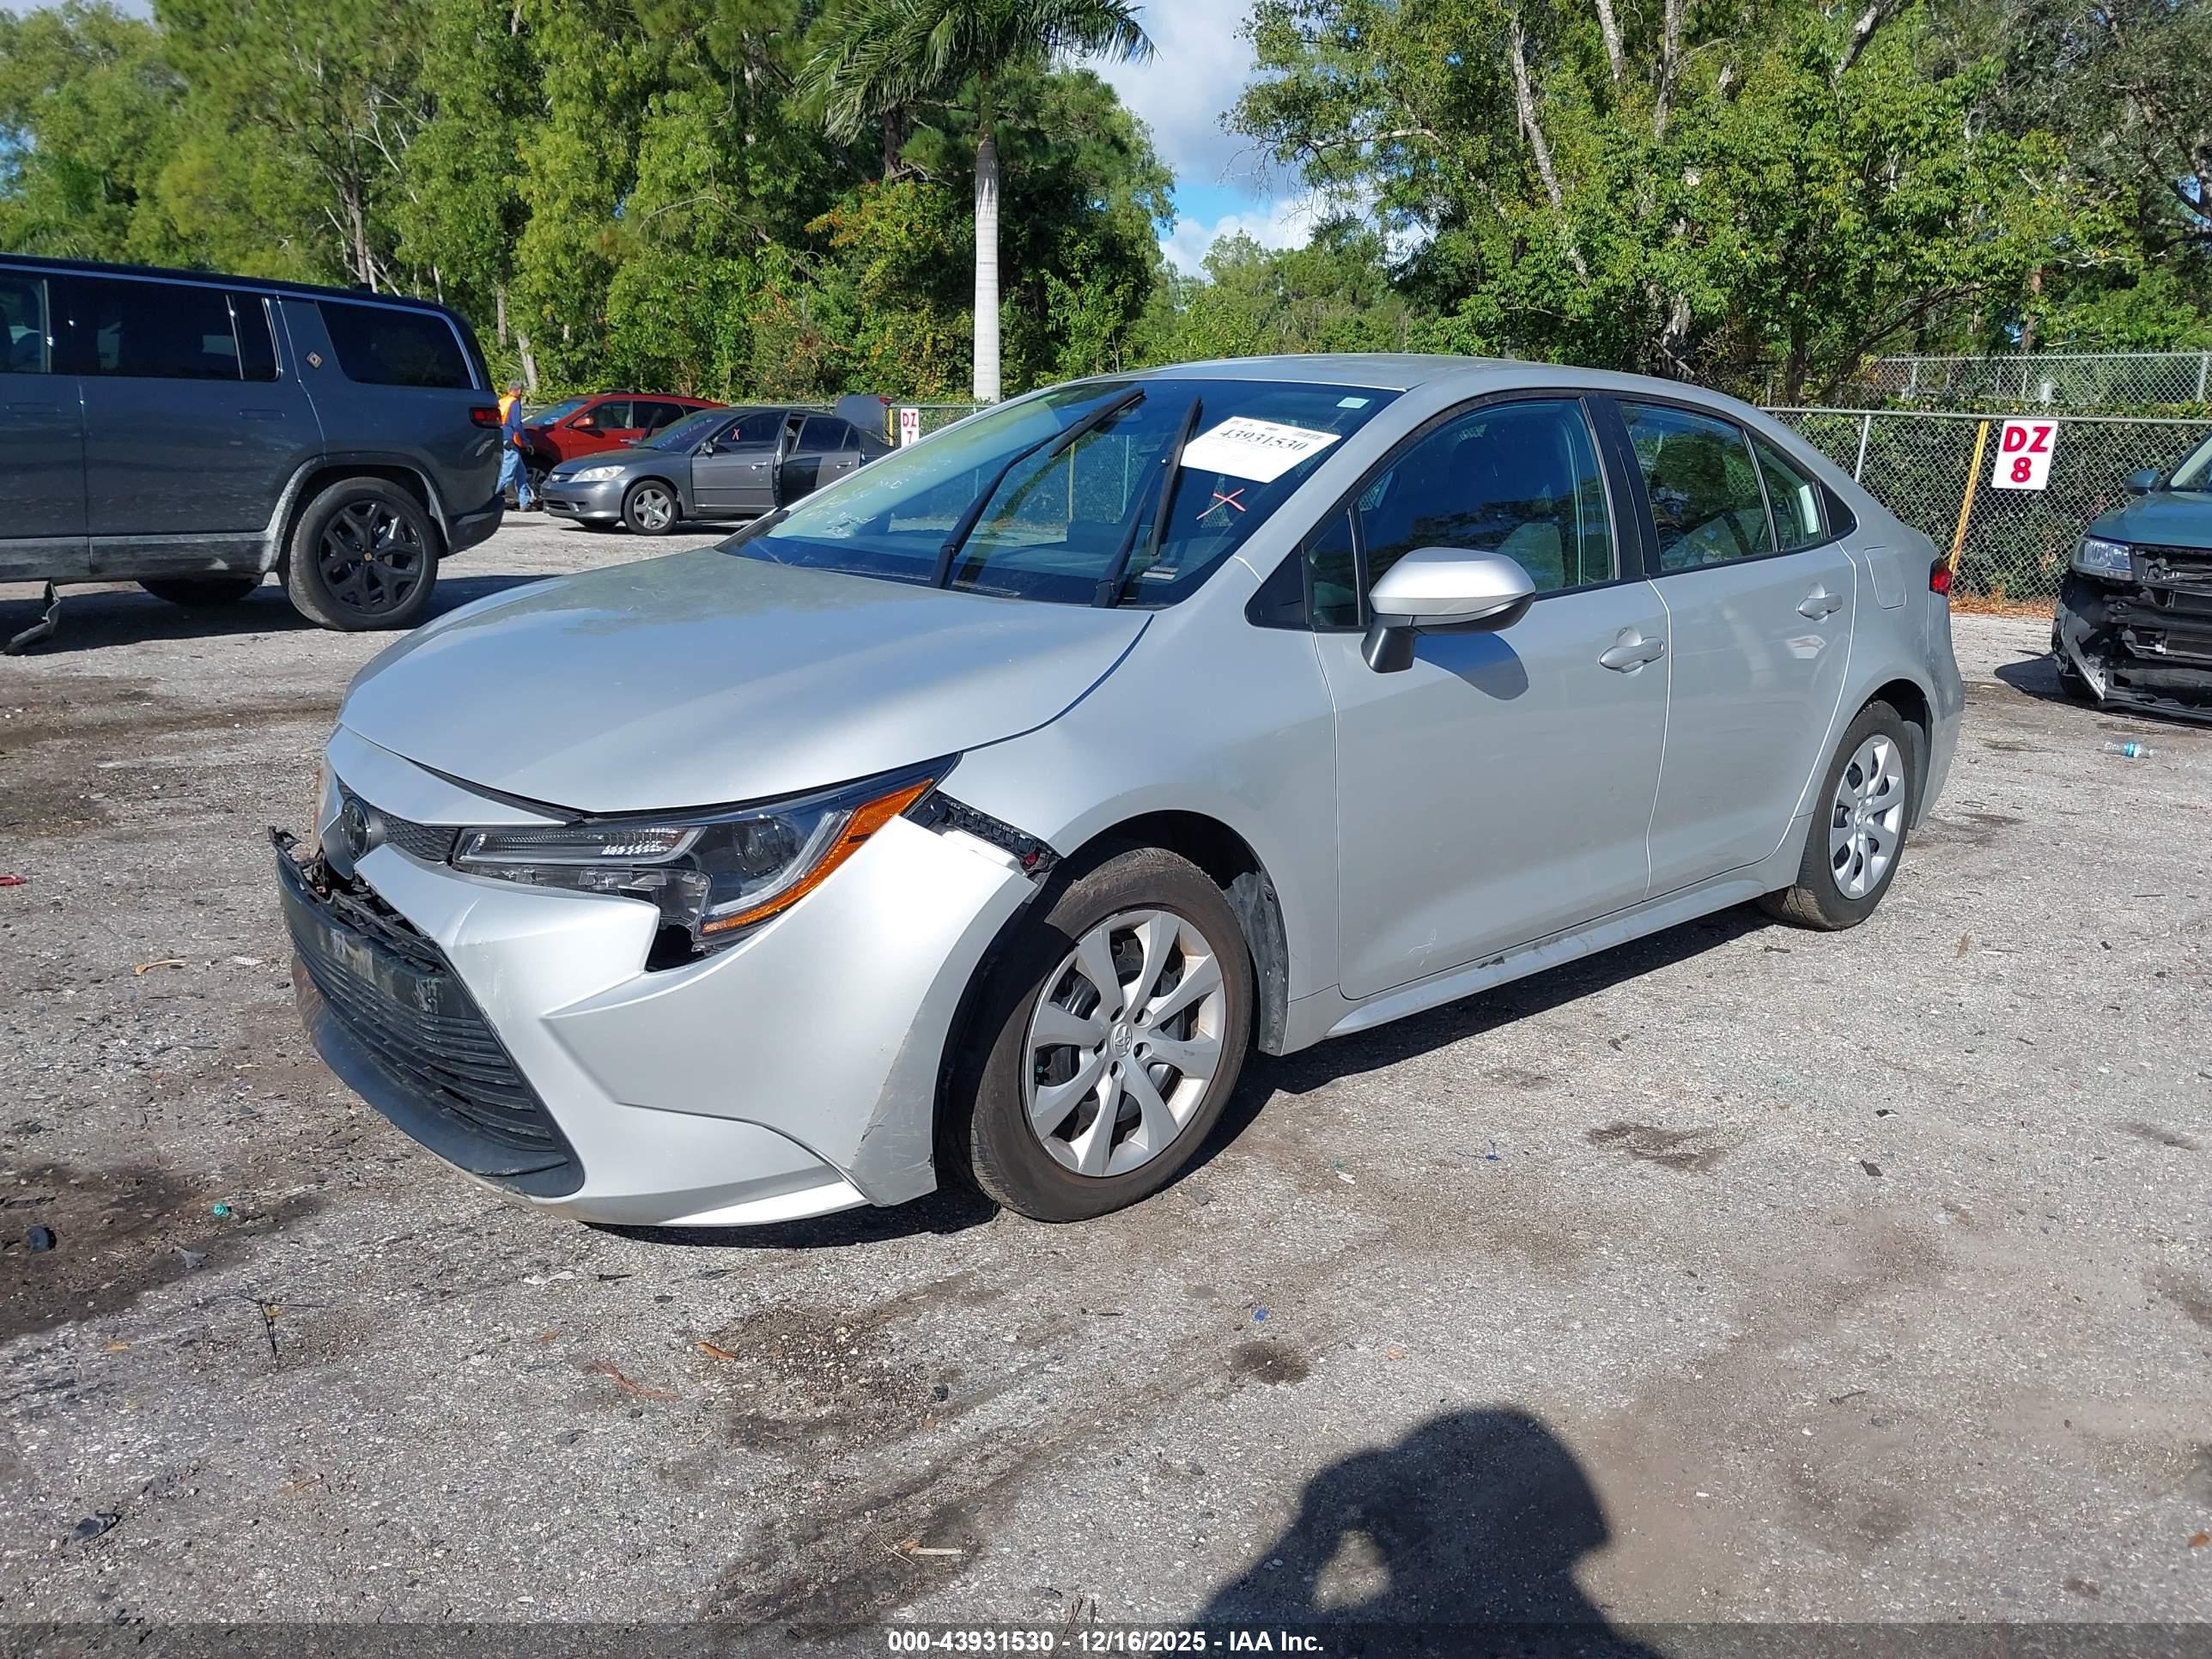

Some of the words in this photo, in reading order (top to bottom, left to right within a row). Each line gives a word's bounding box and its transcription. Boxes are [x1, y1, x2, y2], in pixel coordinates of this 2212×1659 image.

[902, 412, 917, 427] DZ
[907, 430, 913, 444] 7
[1219, 428, 1309, 451] 43931530
[2002, 426, 2053, 453] DZ
[2010, 457, 2032, 483] 8
